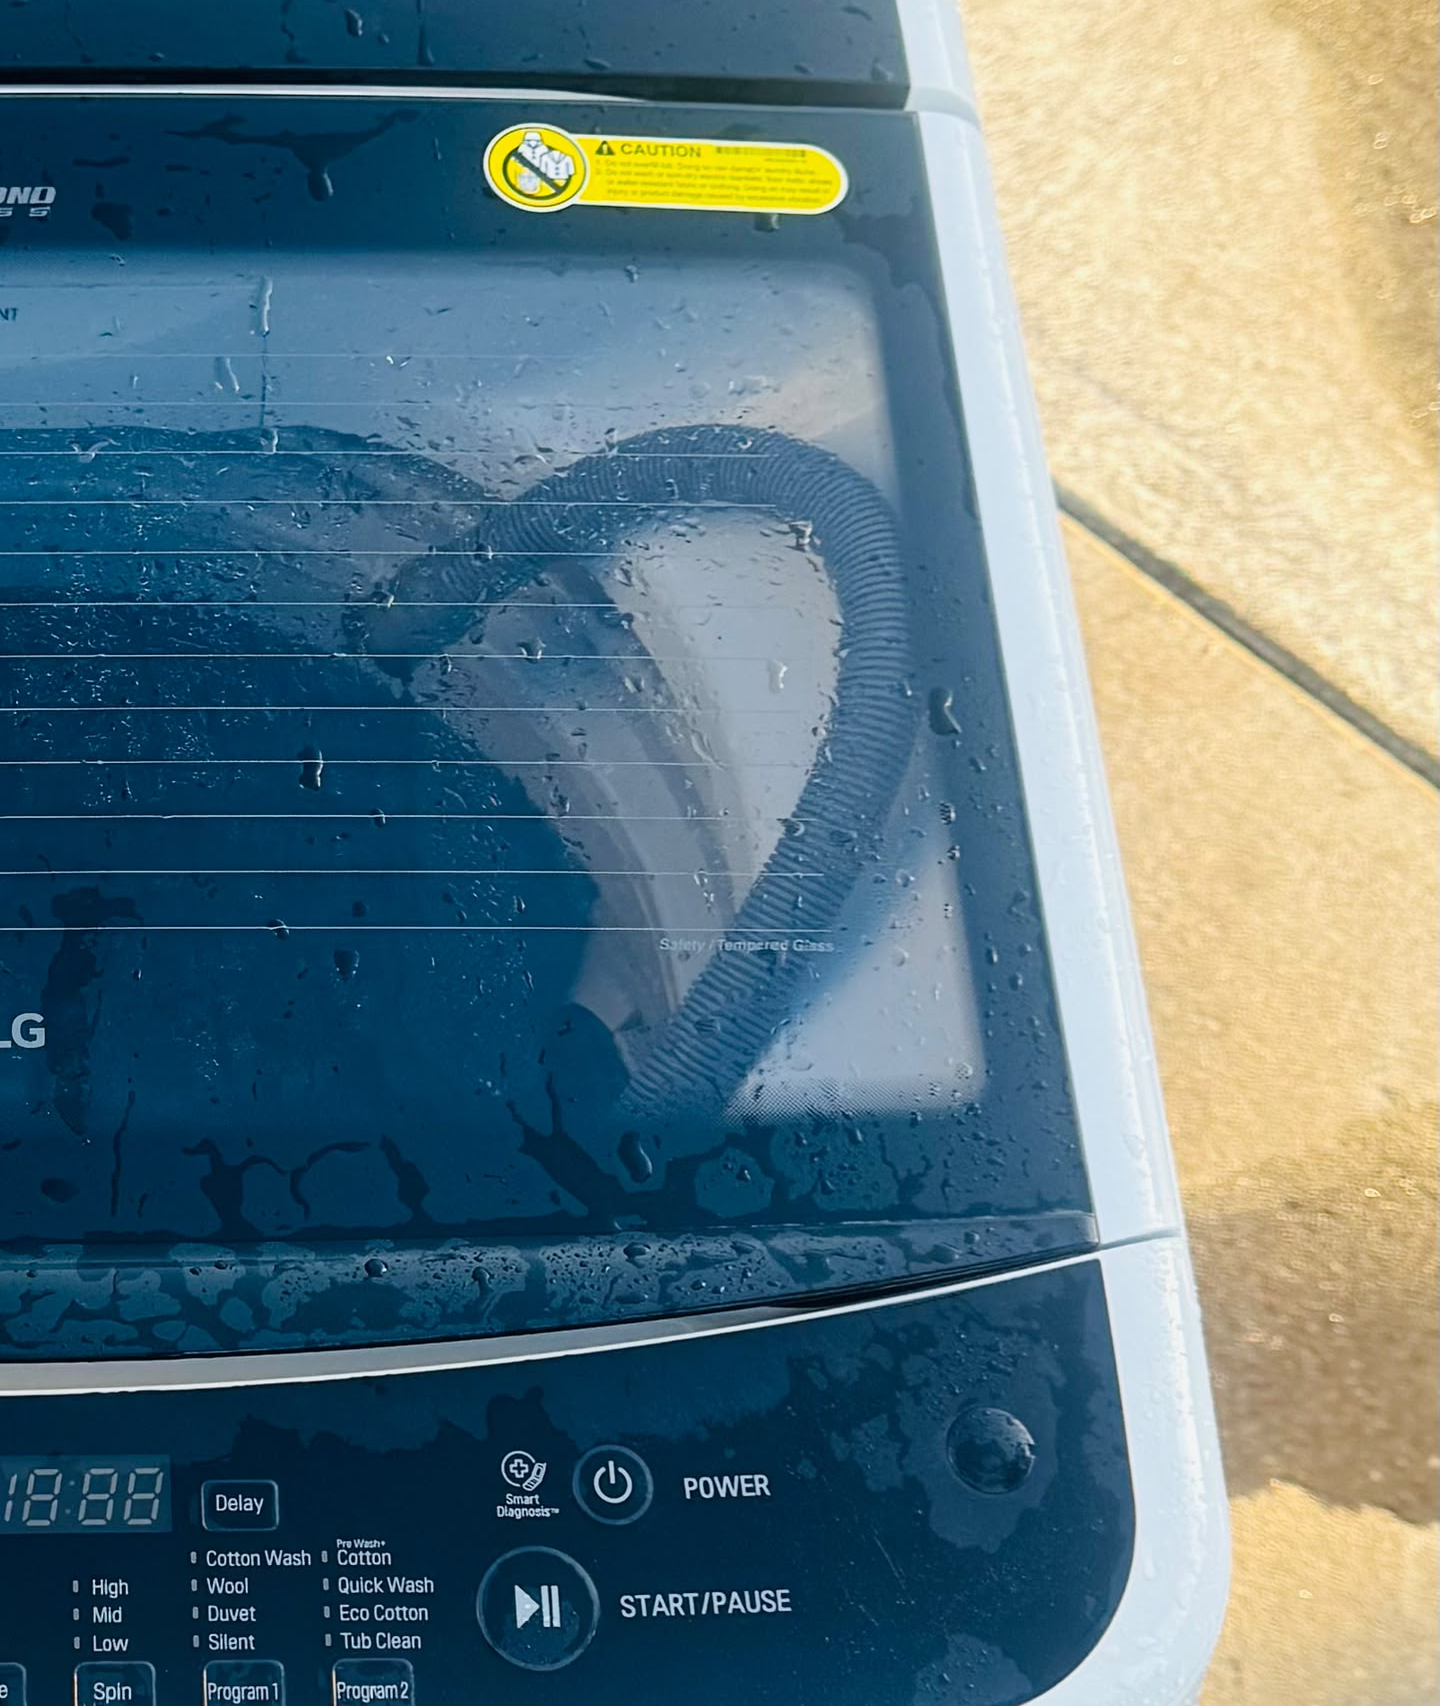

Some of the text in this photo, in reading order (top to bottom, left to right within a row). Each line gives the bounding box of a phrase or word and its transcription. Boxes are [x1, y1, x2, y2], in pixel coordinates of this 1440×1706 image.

[620, 143, 702, 158] CAUTION
[660, 938, 705, 953] Safety
[718, 938, 789, 953] Tempered
[792, 939, 834, 953] Glass
[683, 1474, 771, 1500] POWER
[215, 1494, 264, 1515] Delay
[506, 1494, 539, 1505] Smart
[206, 1550, 311, 1567] Cotton Wash
[337, 1550, 392, 1566] Cotton
[91, 1578, 130, 1598] High
[206, 1578, 249, 1594] Wool
[338, 1576, 434, 1594] Quick Wash
[620, 1589, 792, 1618] START/PAUSE
[92, 1606, 123, 1624] Mid
[207, 1605, 257, 1622] Duvet
[339, 1604, 429, 1622] Eco Cotton
[93, 1635, 129, 1653] Low
[208, 1633, 256, 1651] Silent
[340, 1632, 422, 1649] Tub Clean
[93, 1681, 132, 1703] Spin
[207, 1682, 278, 1704] Program 1
[337, 1682, 409, 1703] Program 2
